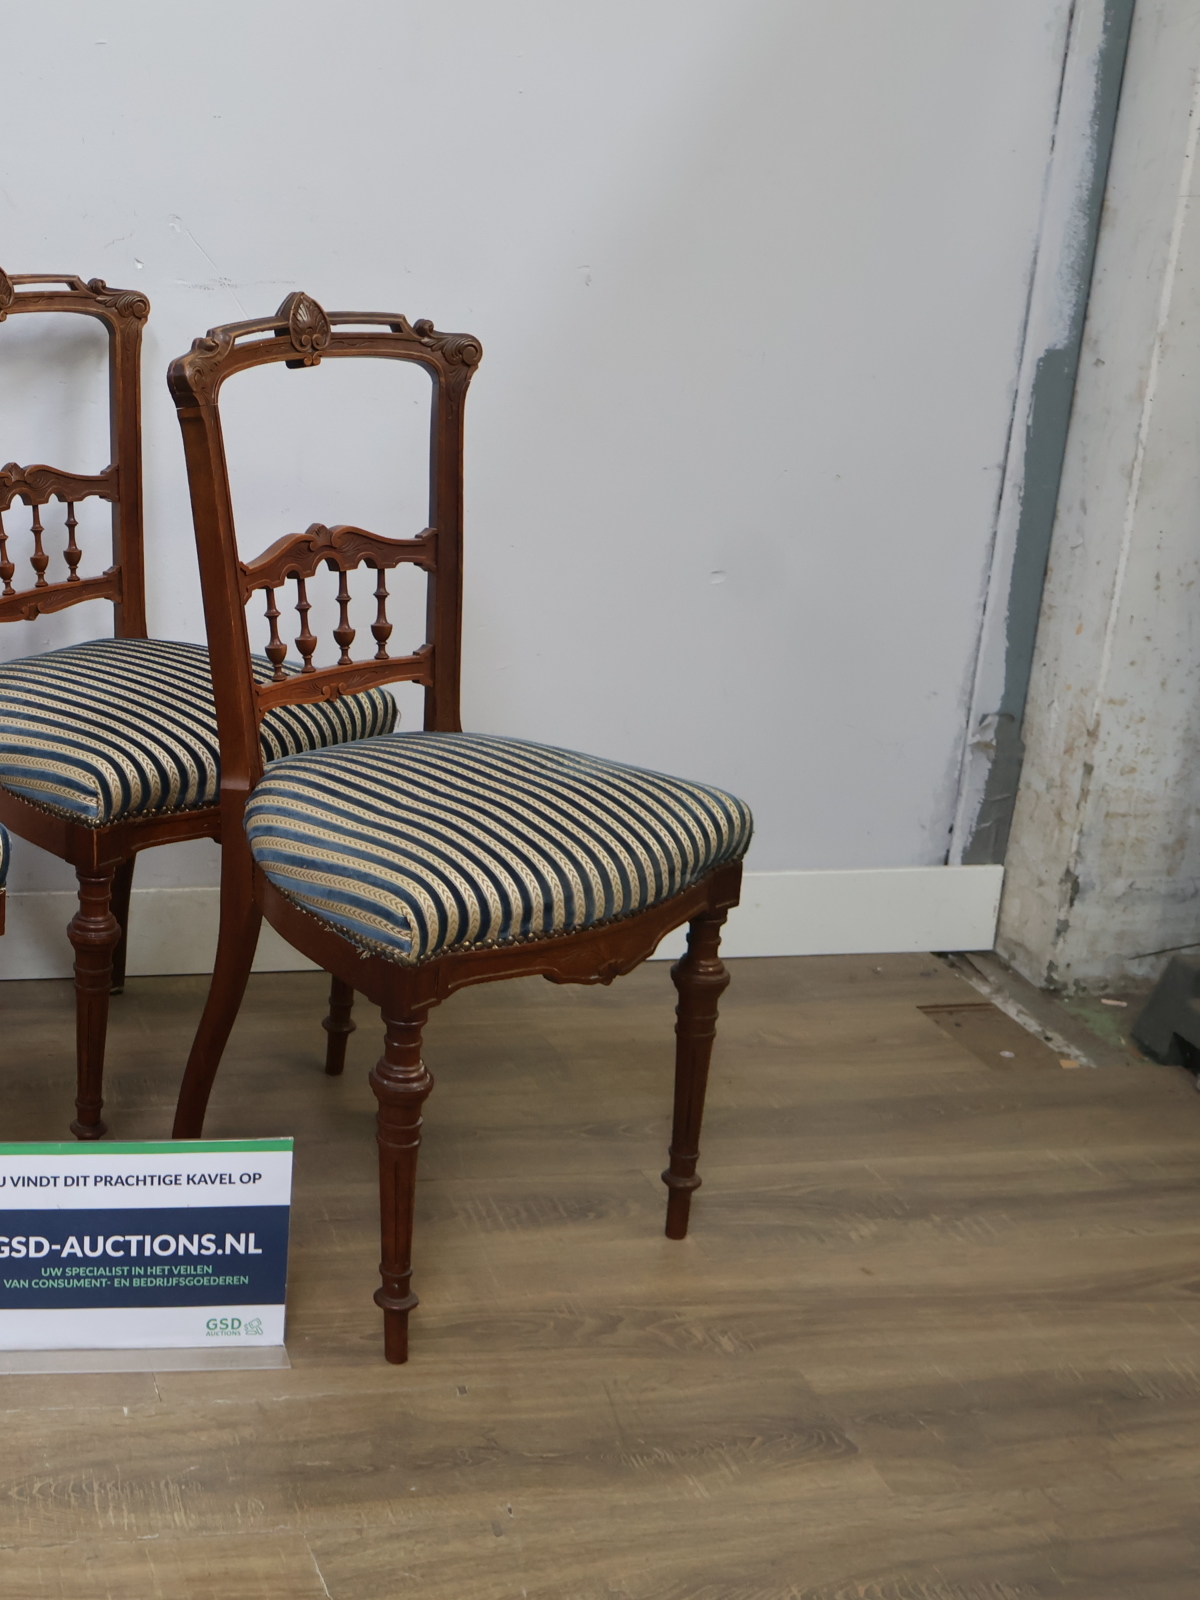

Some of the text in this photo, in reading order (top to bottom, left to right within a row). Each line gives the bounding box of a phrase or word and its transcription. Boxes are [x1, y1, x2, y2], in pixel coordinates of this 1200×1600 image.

[10, 1175, 60, 1188] VINDT
[63, 1174, 90, 1187] DIT
[93, 1173, 183, 1187] PRACHTIGE
[187, 1172, 236, 1185] KAVEL
[239, 1172, 262, 1184] OP
[41, 1264, 213, 1277] UW SPECIALIST IN HET VEILEN
[3, 1275, 249, 1289] VAN CONSUMENT- EN BEDRIJFSGOEDEREN
[206, 1317, 242, 1331] GSD
